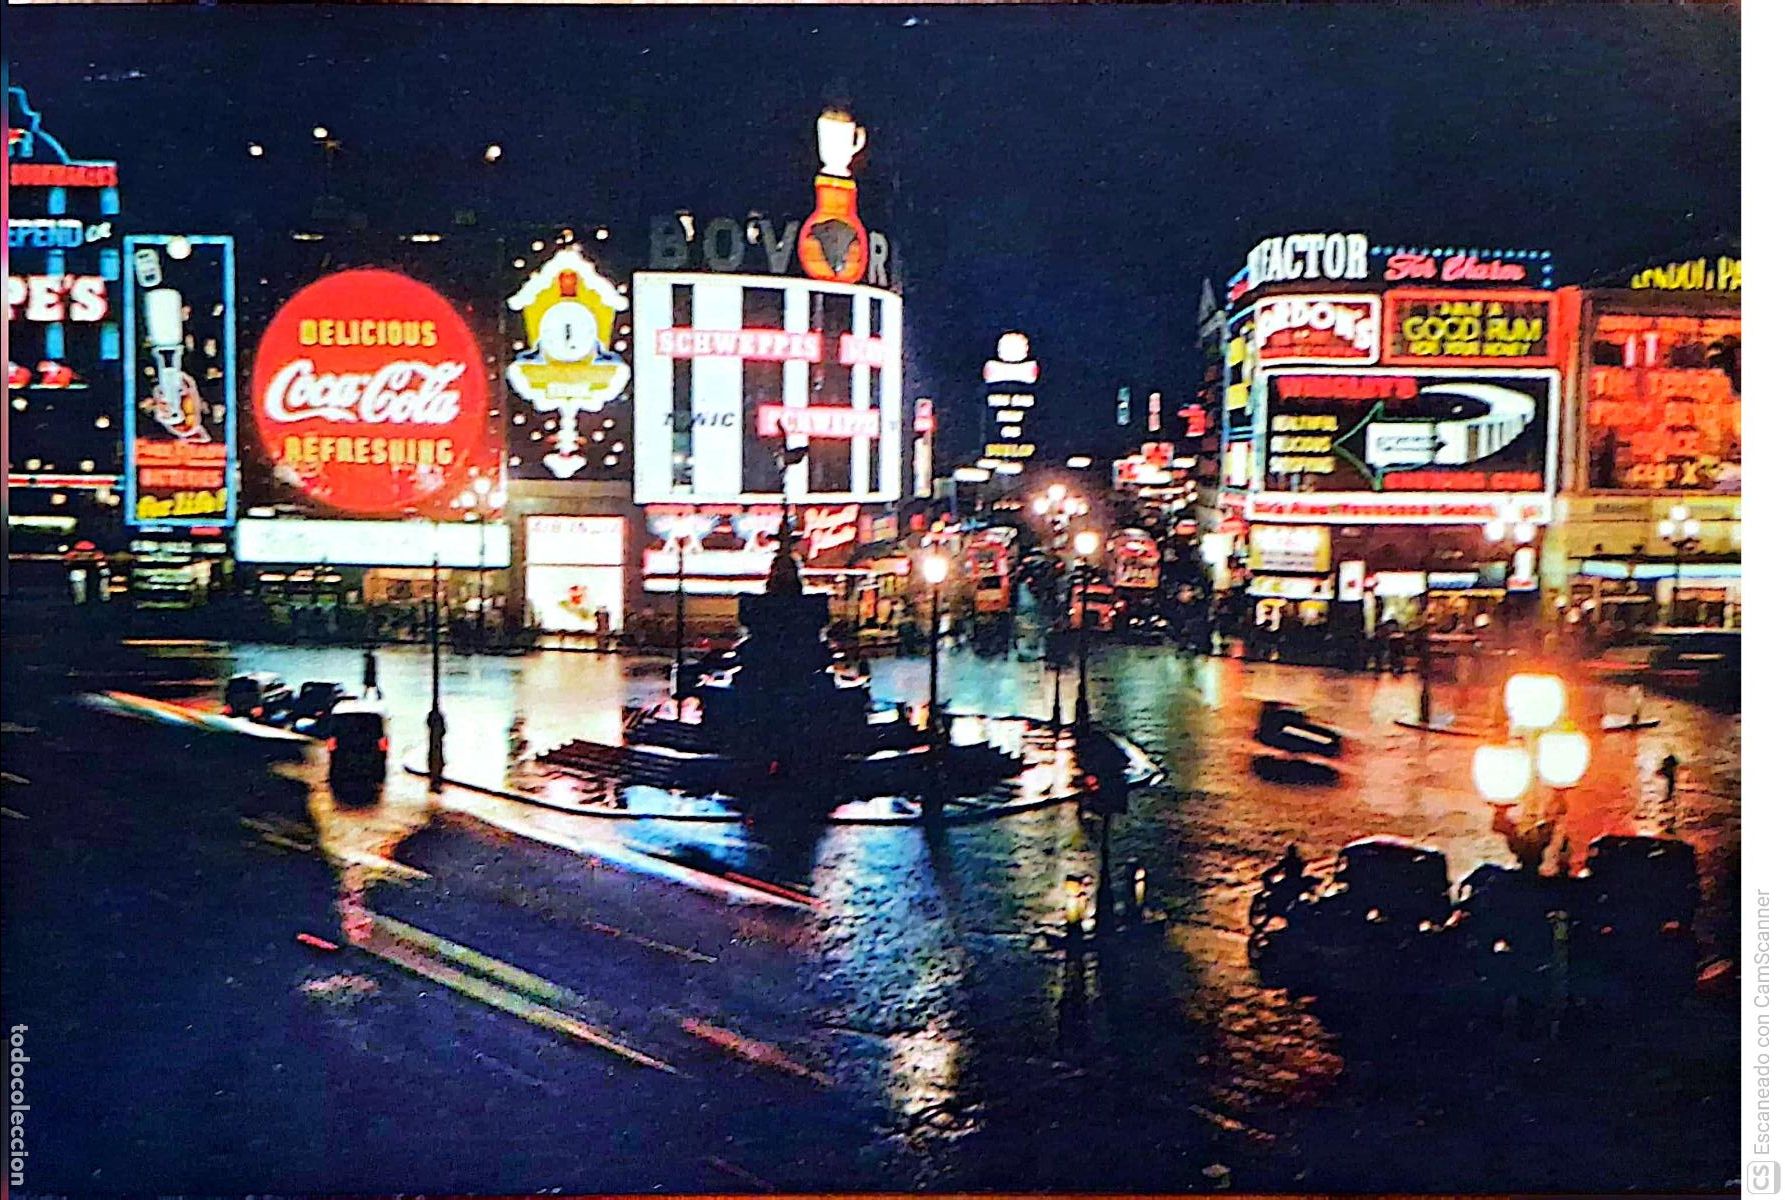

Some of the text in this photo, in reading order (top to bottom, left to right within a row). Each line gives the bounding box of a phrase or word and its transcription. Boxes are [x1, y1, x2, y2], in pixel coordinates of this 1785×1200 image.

[299, 319, 439, 347] DELICIOUS
[1401, 316, 1481, 342] GOOD
[283, 434, 455, 466] REFRESHING
